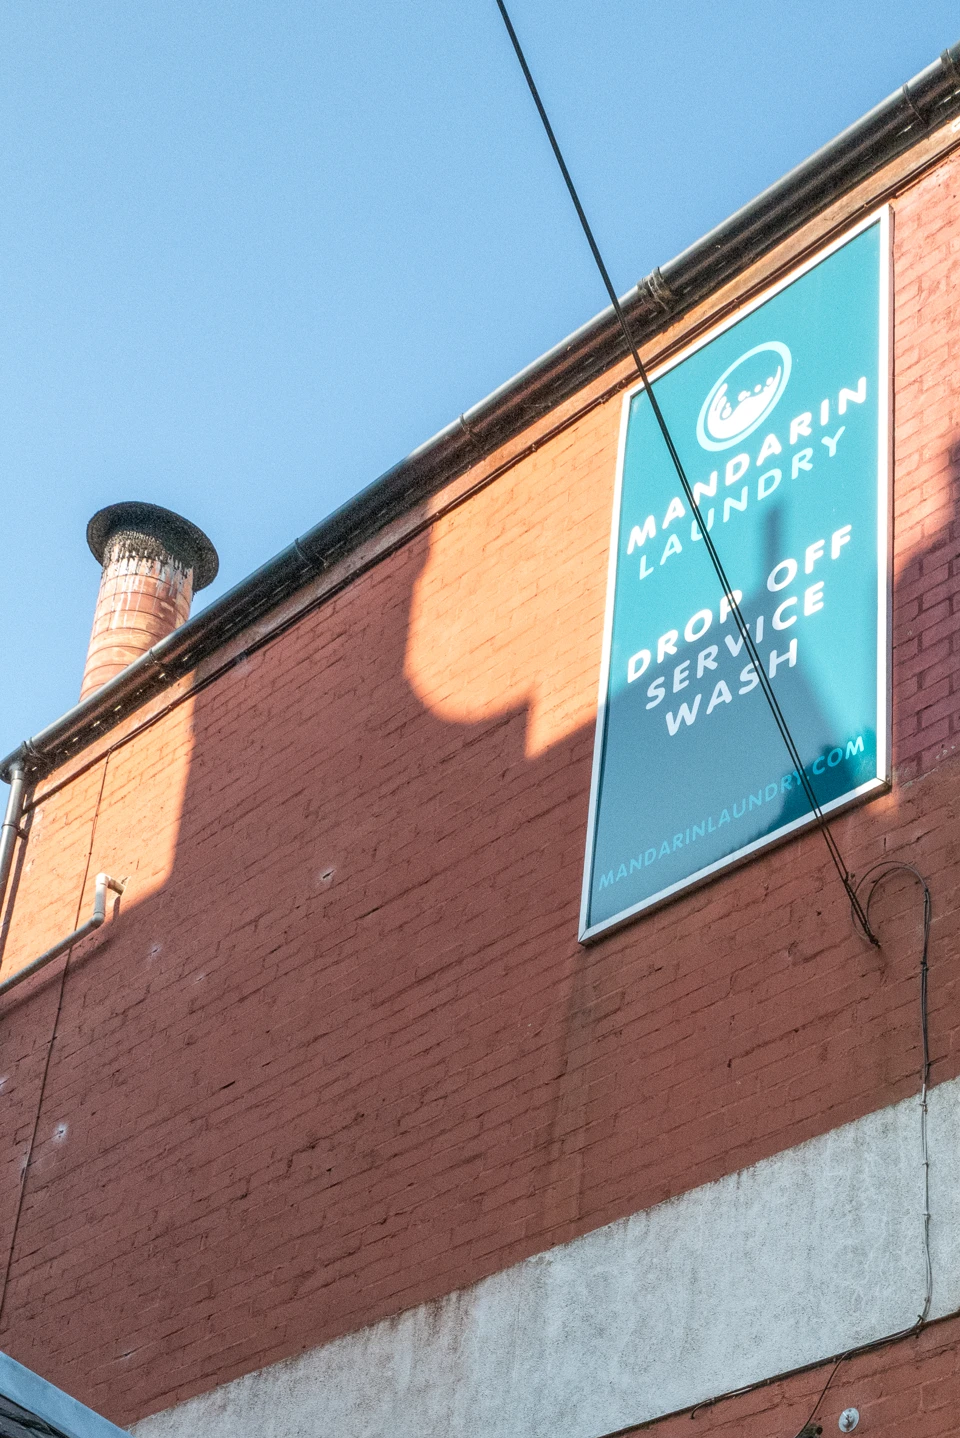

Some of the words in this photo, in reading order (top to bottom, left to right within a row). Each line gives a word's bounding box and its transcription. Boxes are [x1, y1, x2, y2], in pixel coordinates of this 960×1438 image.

[627, 376, 867, 555] MANDARIN
[639, 426, 846, 580] LAUNDRY
[627, 589, 743, 684] DROP
[766, 524, 852, 592] OFF
[645, 581, 825, 710] SERVICE
[665, 638, 798, 737] WASH
[599, 736, 865, 890] MANDARINLAUNDRY.COM
